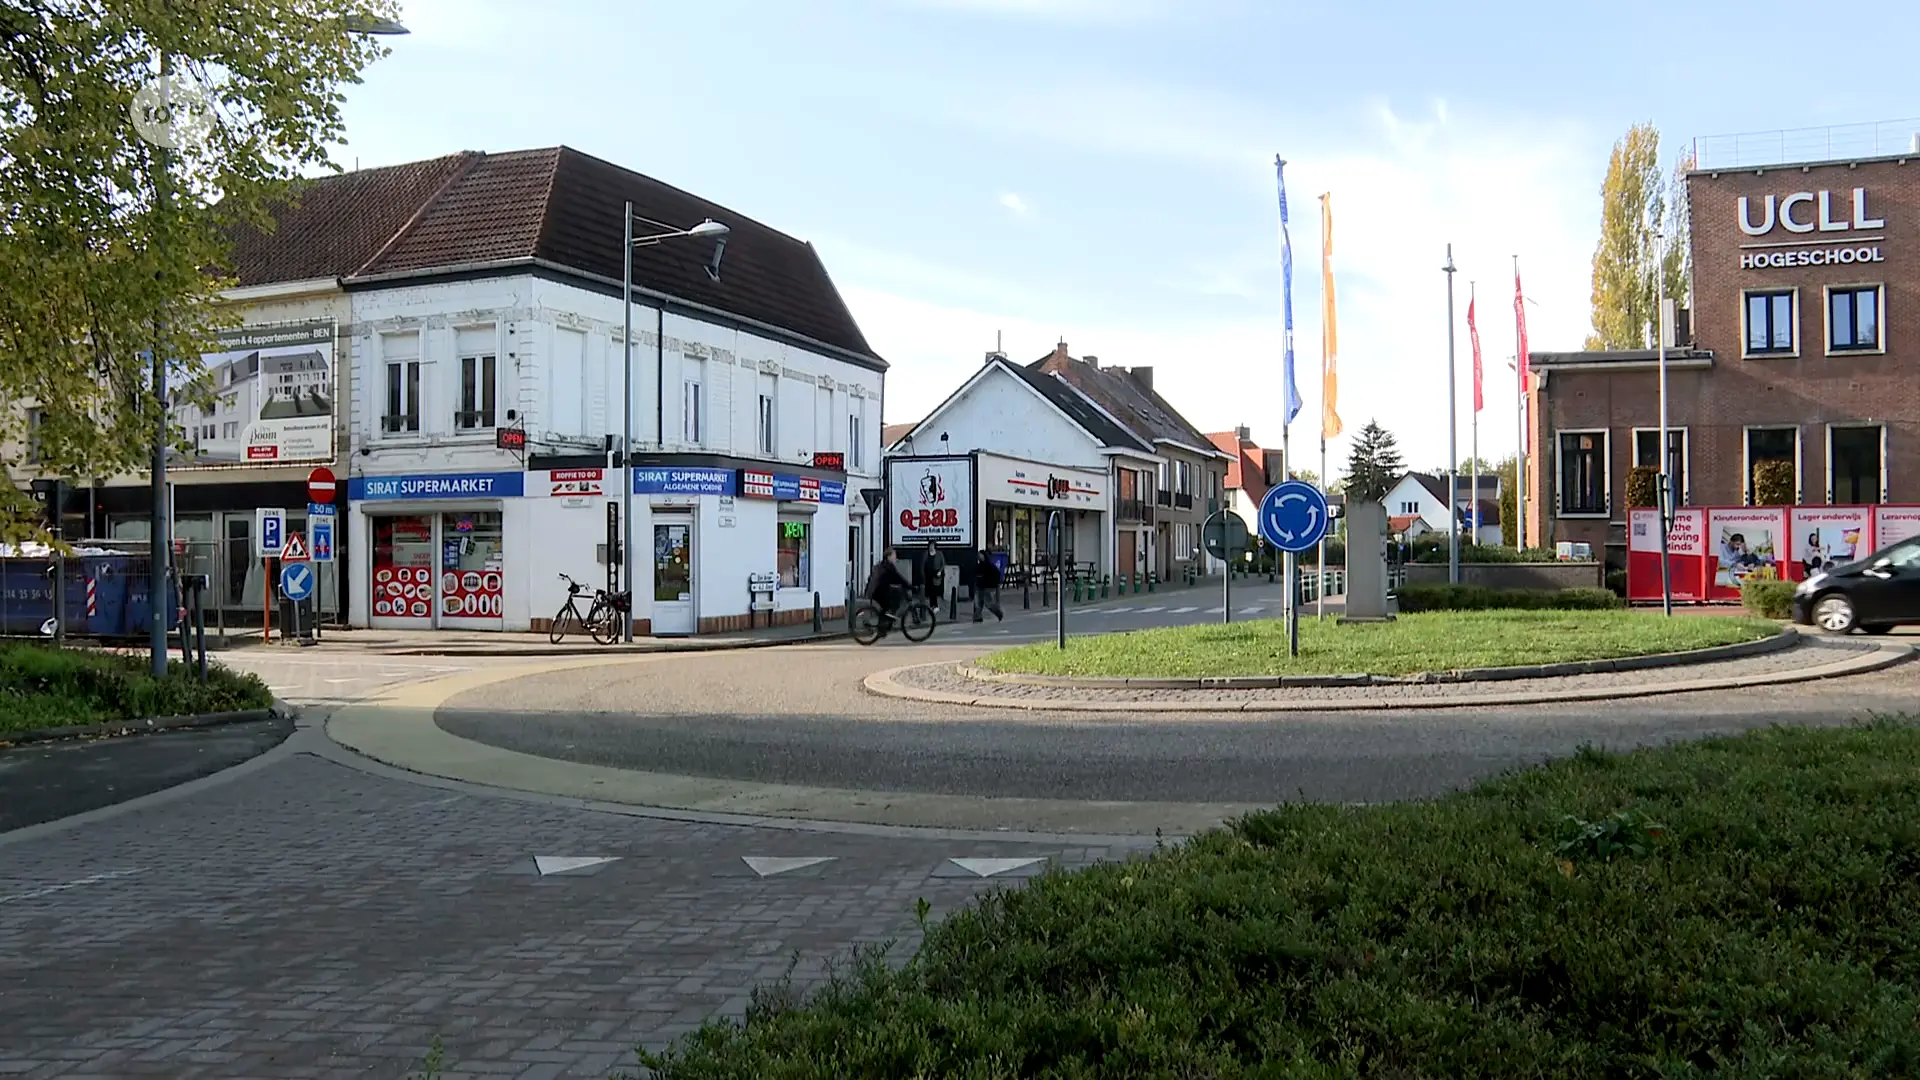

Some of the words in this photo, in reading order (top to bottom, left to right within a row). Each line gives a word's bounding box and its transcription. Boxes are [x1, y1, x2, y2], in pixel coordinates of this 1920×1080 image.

[1737, 187, 1885, 236] UCLL
[1740, 246, 1884, 269] HOGESCHOOL
[253, 330, 310, 344] appartementen
[502, 433, 523, 444] OPEN
[815, 457, 840, 466] OPEN
[556, 471, 577, 480] KOFFIE
[578, 471, 586, 479] TO
[587, 470, 597, 479] GO
[638, 471, 669, 482] SIRAT
[671, 470, 728, 483] SUPERMARKET
[366, 481, 398, 496] SIRAT
[400, 478, 494, 494] SUPERMARKET
[663, 483, 699, 491] ALGEMENE
[314, 505, 325, 513] 50
[325, 506, 333, 514] m
[1713, 514, 1778, 522] Kleuteronderwijs
[1798, 514, 1819, 522] Lager
[1821, 513, 1861, 521] onderwijs
[266, 519, 277, 536] P
[456, 521, 473, 530] OPEN
[785, 523, 804, 538] OPEN
